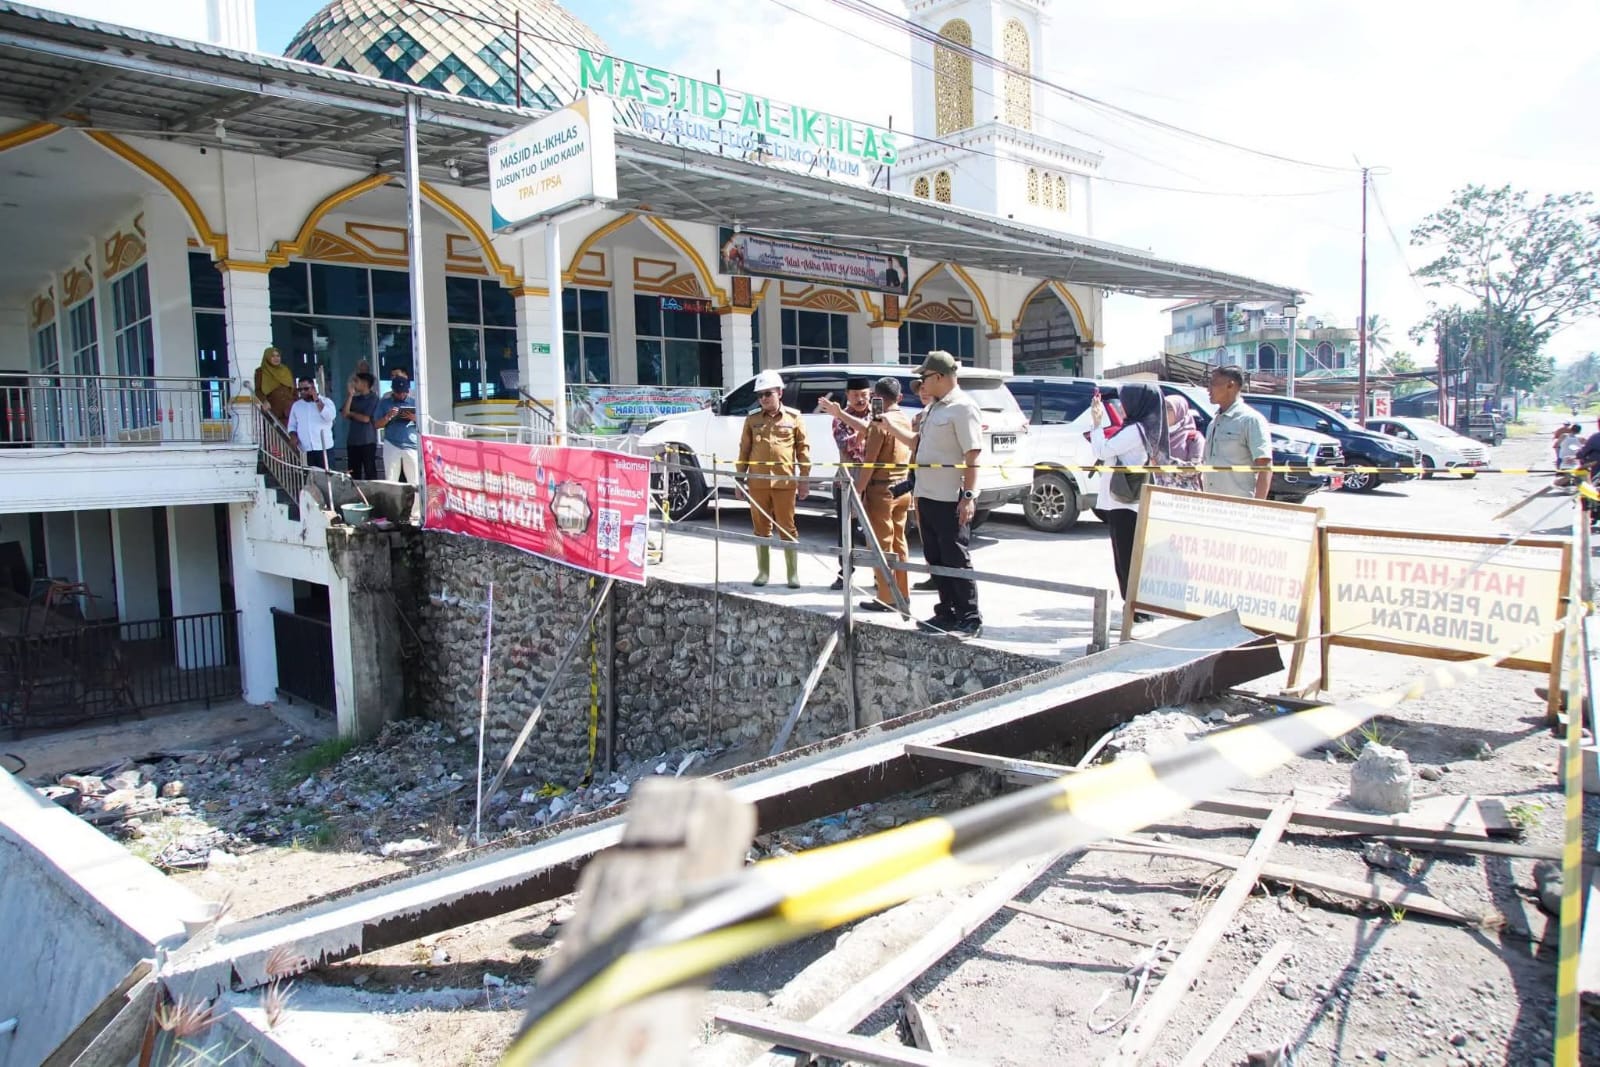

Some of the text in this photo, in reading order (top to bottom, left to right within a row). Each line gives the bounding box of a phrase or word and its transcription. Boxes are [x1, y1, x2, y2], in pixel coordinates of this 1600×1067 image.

[578, 48, 899, 165] MASJID AL-IKHLAS
[500, 125, 578, 171] MASJID AL-IKHLAS
[642, 111, 860, 177] DUSUN TUO LIMO KAUM
[496, 142, 584, 189] DUSUN TUO LIMO KAUM
[518, 186, 535, 201] TPA
[540, 174, 562, 193] TPSA
[615, 405, 636, 415] MARI
[614, 459, 648, 472] Telkomsel
[484, 470, 506, 494] Hari
[508, 473, 537, 500] Raya
[607, 484, 644, 499] Telkomsel
[465, 489, 500, 521] Adha
